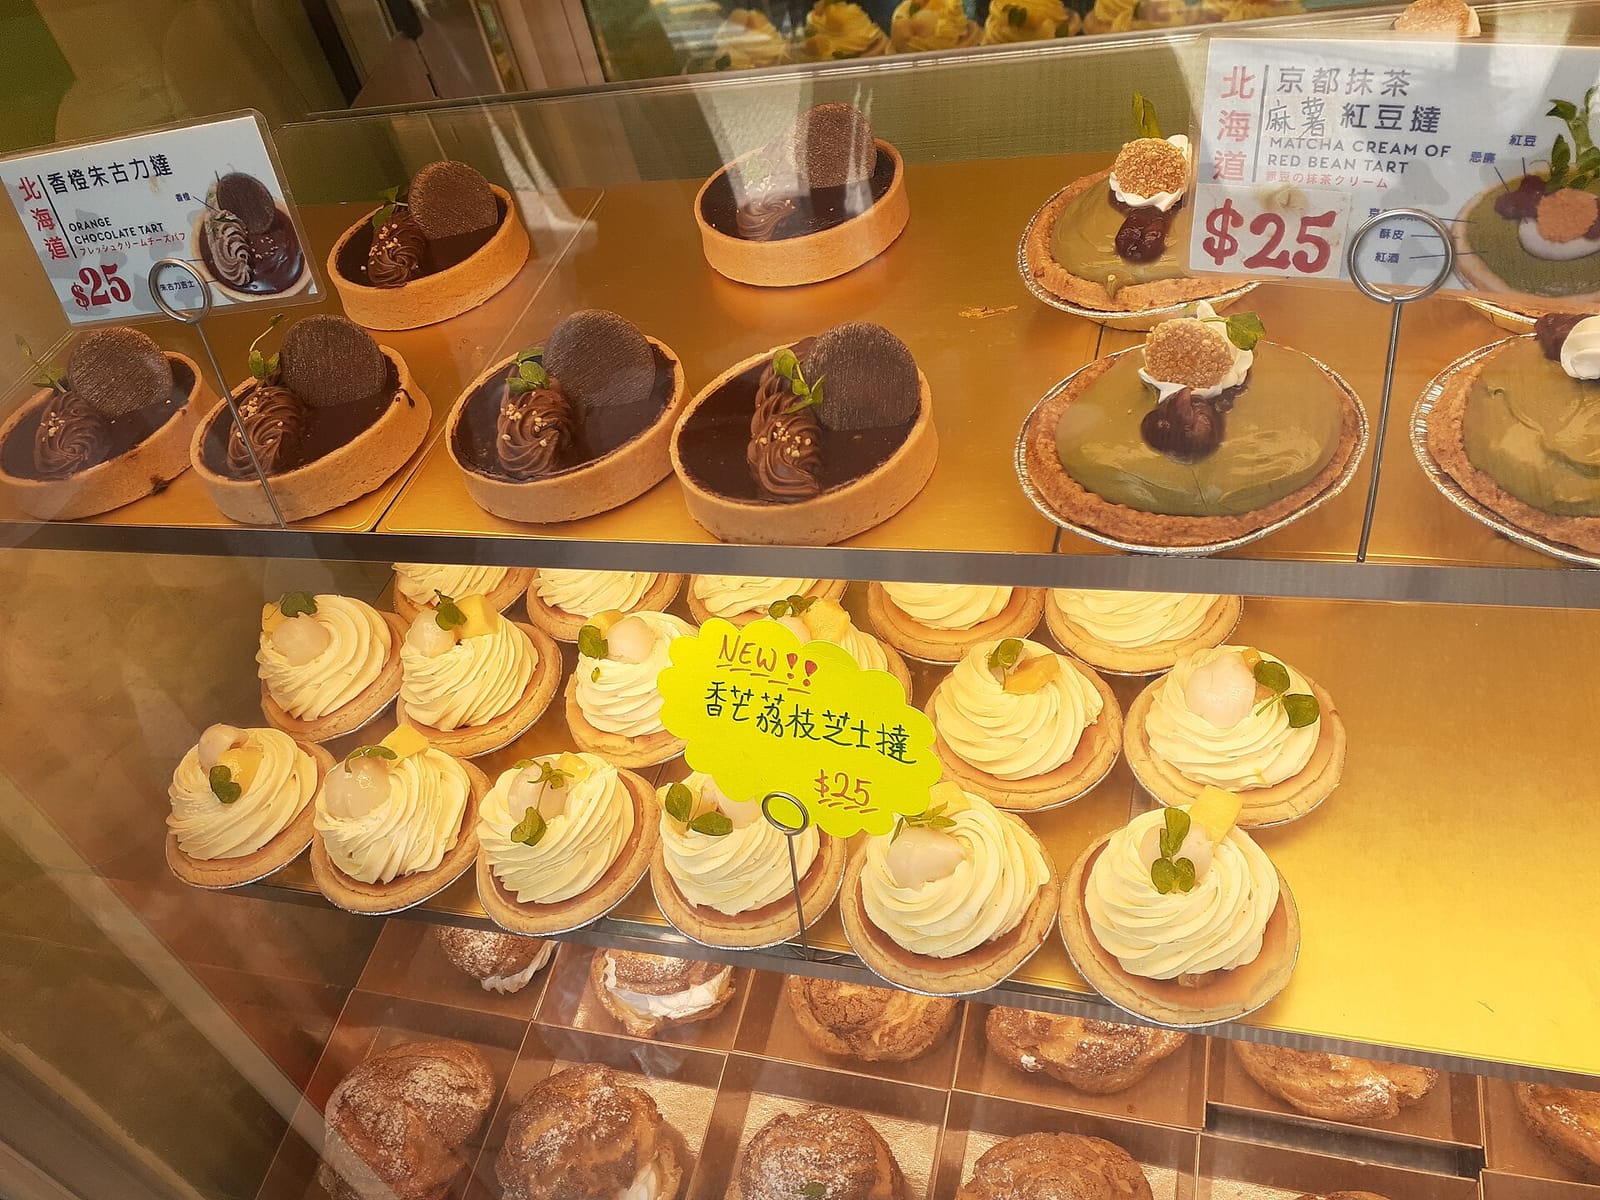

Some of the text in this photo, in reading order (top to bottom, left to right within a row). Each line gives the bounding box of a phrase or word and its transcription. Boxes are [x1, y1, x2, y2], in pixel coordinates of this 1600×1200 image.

[1276, 66, 1412, 98] 京都抹茶
[1211, 65, 1256, 182] 北海道
[1265, 96, 1442, 137] 麻薯 紅豆撻
[1269, 137, 1452, 158] MATCHA CREAM OF
[1508, 134, 1537, 147] 紅豆
[47, 153, 173, 195] 香橙朱古力撻
[1267, 155, 1409, 174] RED BEAN TART
[18, 175, 69, 260] 北海道
[69, 217, 112, 233] ORANGE
[74, 222, 164, 245] CHOCOLATE TART
[1202, 198, 1338, 274] $25
[1379, 228, 1404, 241] 酥皮
[70, 264, 132, 311] $25
[704, 681, 917, 765] 香芒荔枝芝士撻
[814, 769, 872, 806] $25
